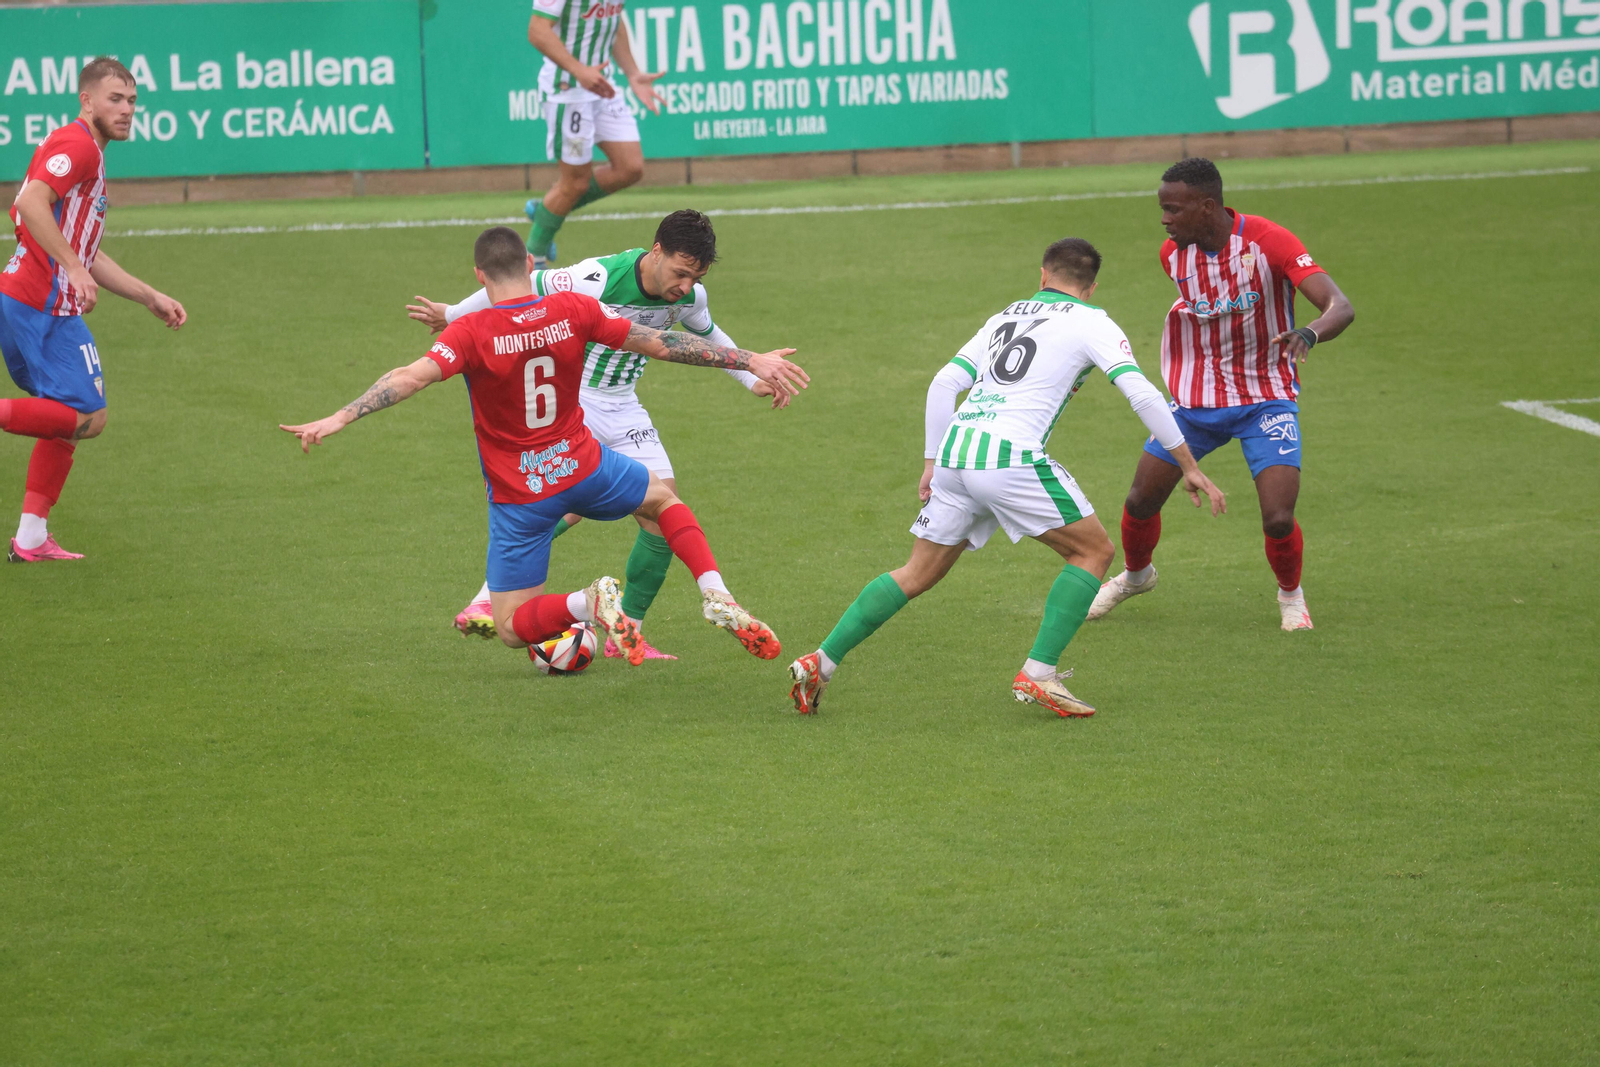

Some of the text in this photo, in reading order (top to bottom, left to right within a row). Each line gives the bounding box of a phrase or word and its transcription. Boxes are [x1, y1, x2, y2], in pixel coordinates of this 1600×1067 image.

[722, 0, 957, 71] BACHICHA
[169, 53, 223, 91] La
[236, 49, 395, 89] ballena
[752, 77, 811, 111] FRITO
[816, 76, 831, 108] Y
[835, 73, 902, 107] TAPAS
[906, 67, 1009, 104] VARIADAS
[1351, 55, 1600, 101] Material Méd
[188, 109, 211, 140] Y
[222, 98, 394, 139] CERÁMICA
[570, 110, 582, 134] 8
[693, 120, 711, 140] LA
[712, 117, 768, 139] REYERTA
[776, 116, 794, 137] LA
[79, 342, 102, 375] 14
[523, 355, 557, 430] 6
